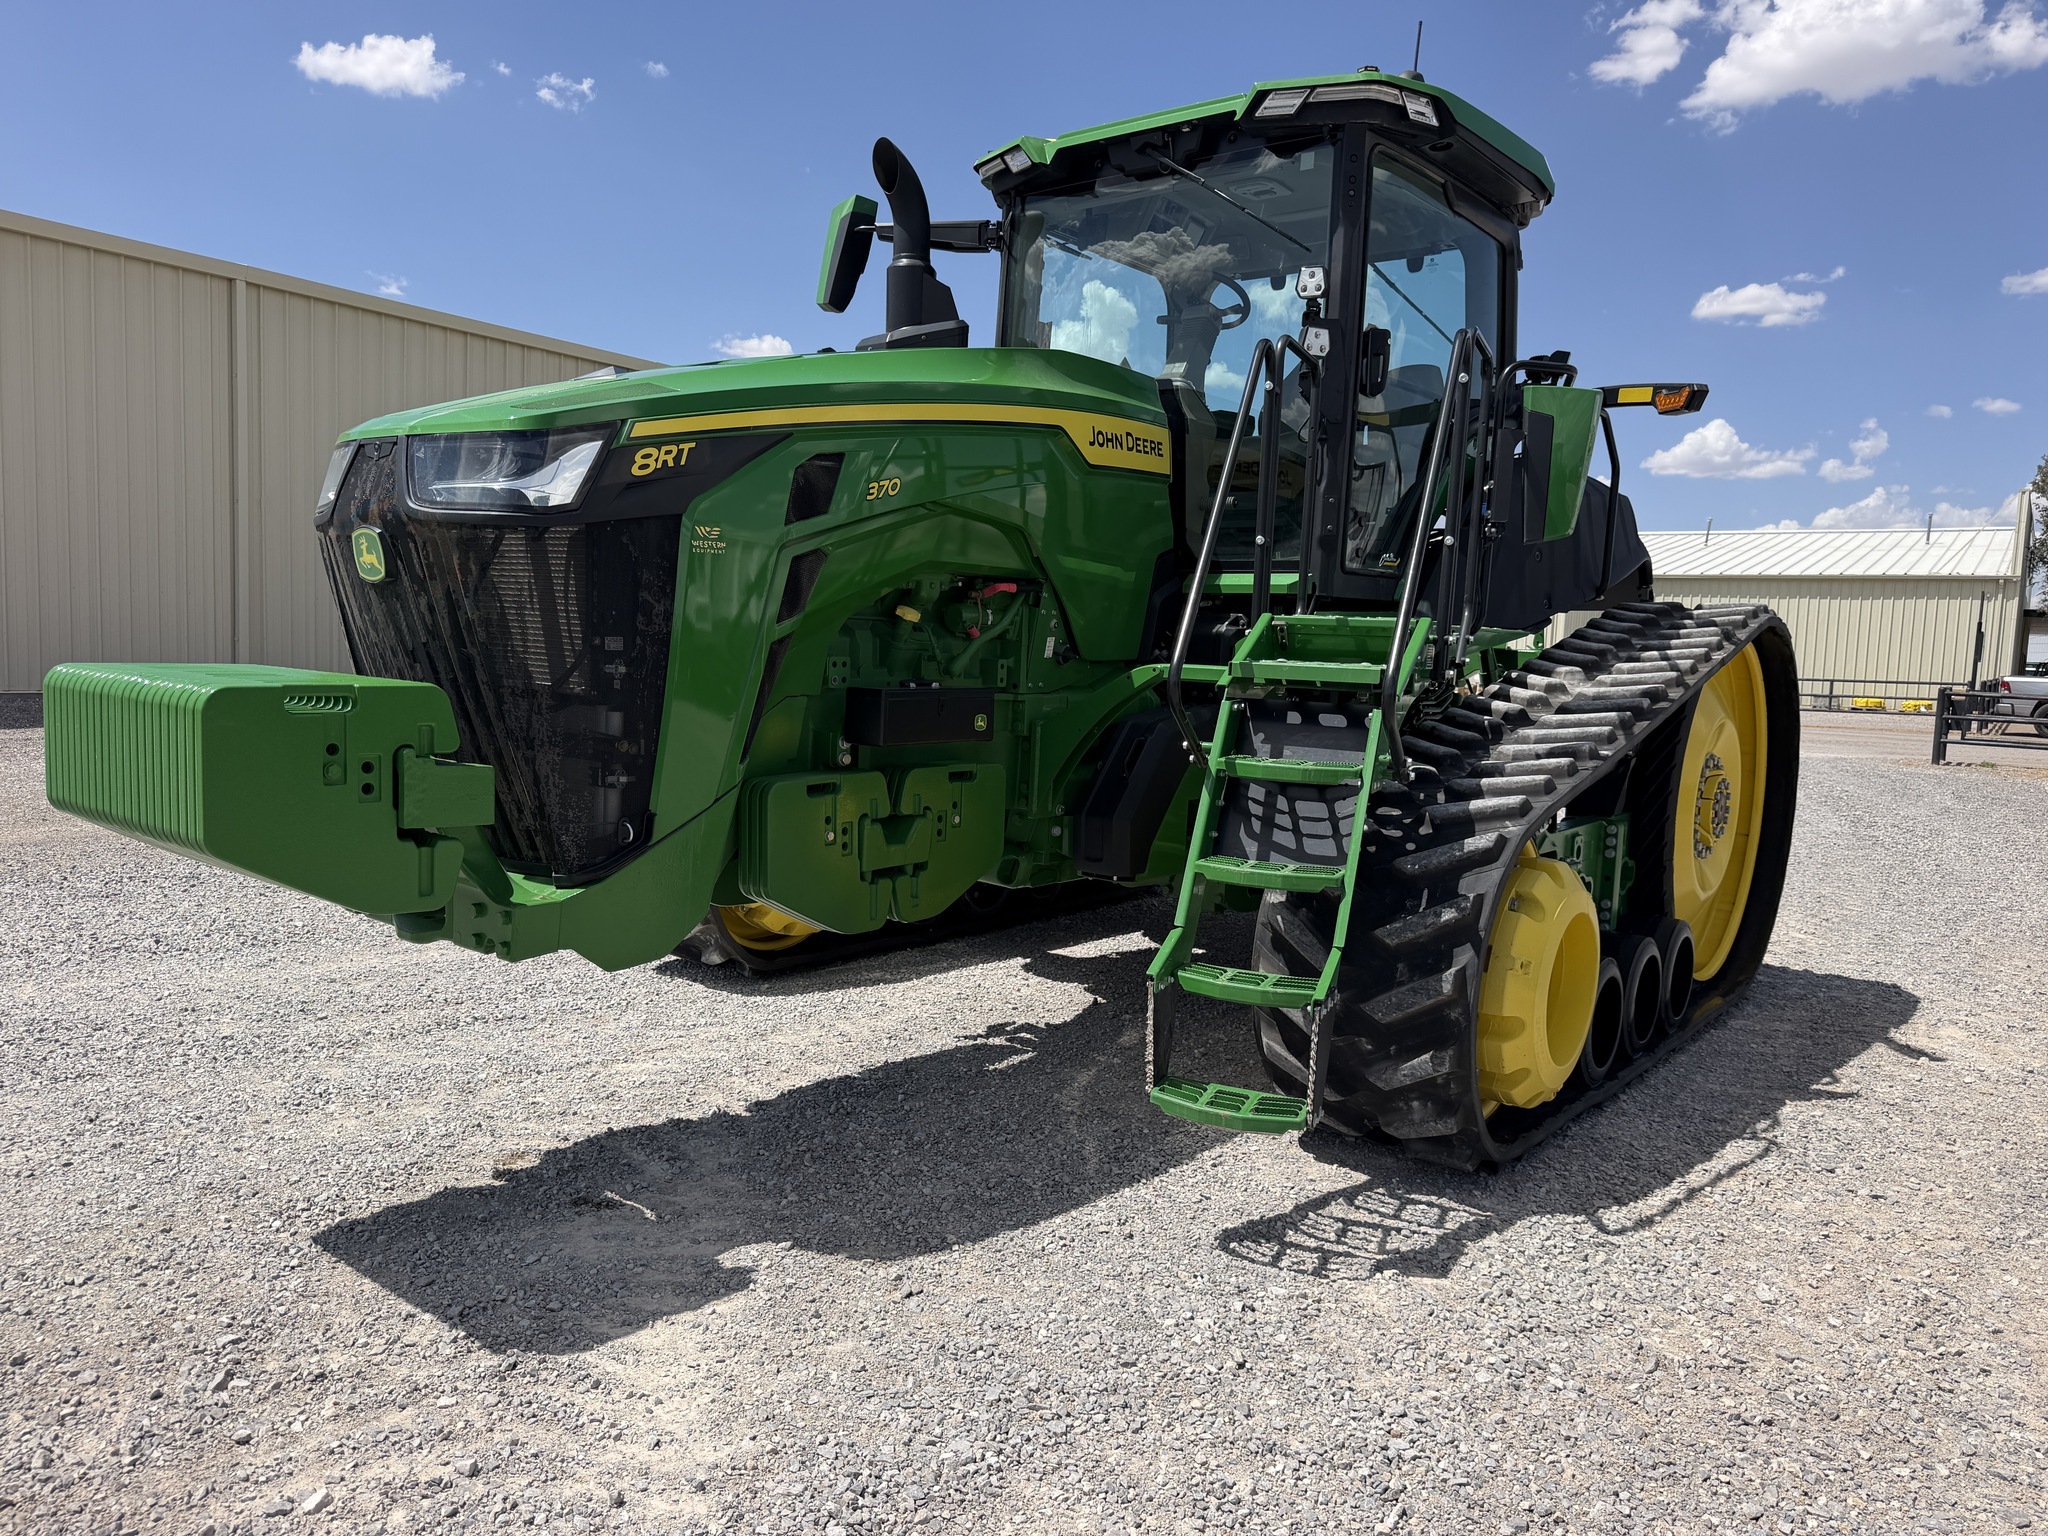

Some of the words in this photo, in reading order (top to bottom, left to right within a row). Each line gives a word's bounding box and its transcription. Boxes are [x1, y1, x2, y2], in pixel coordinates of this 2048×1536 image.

[1089, 425, 1123, 451] JOHN
[1125, 431, 1164, 458] DEERE
[631, 442, 696, 476] 8RT
[866, 478, 901, 500] 370
[691, 540, 727, 549] WESTERN
